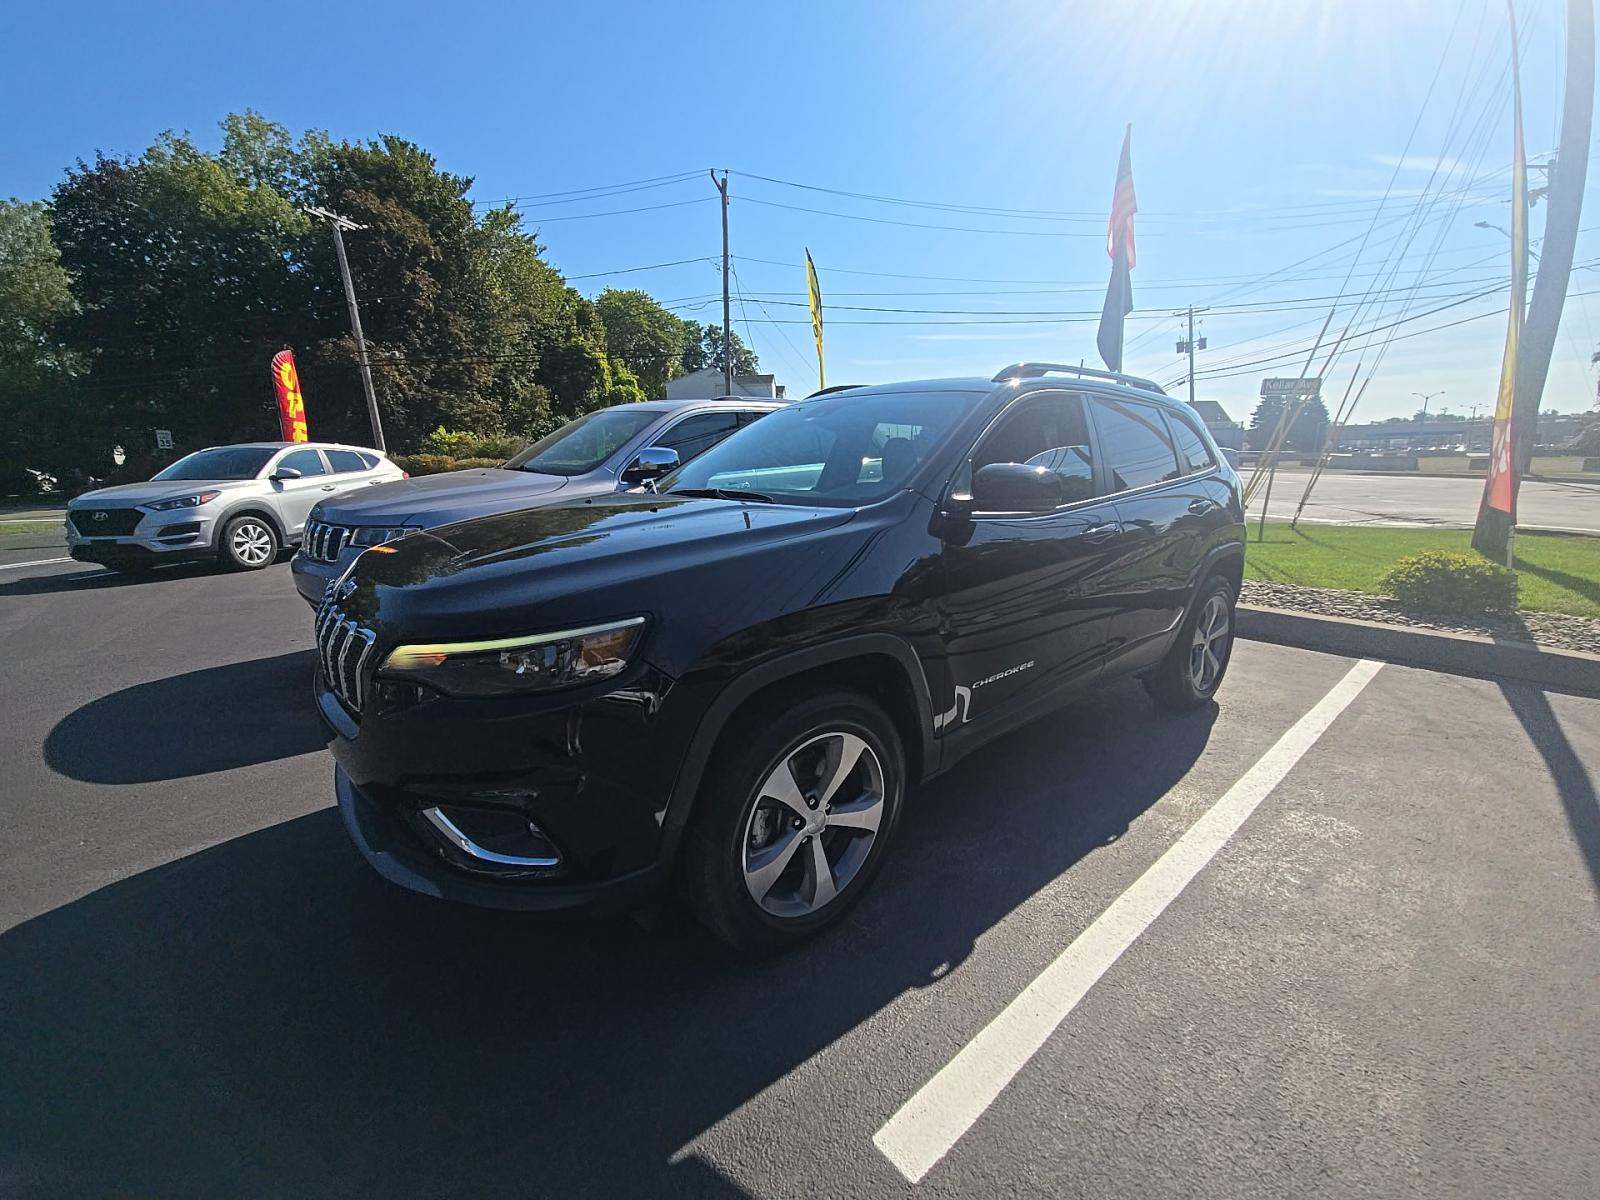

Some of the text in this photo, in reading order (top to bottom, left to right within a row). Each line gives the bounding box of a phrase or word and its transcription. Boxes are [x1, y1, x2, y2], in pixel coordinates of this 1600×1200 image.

[281, 362, 308, 443] OPE
[159, 439, 171, 447] 35
[972, 660, 1035, 689] CHEROKEE
